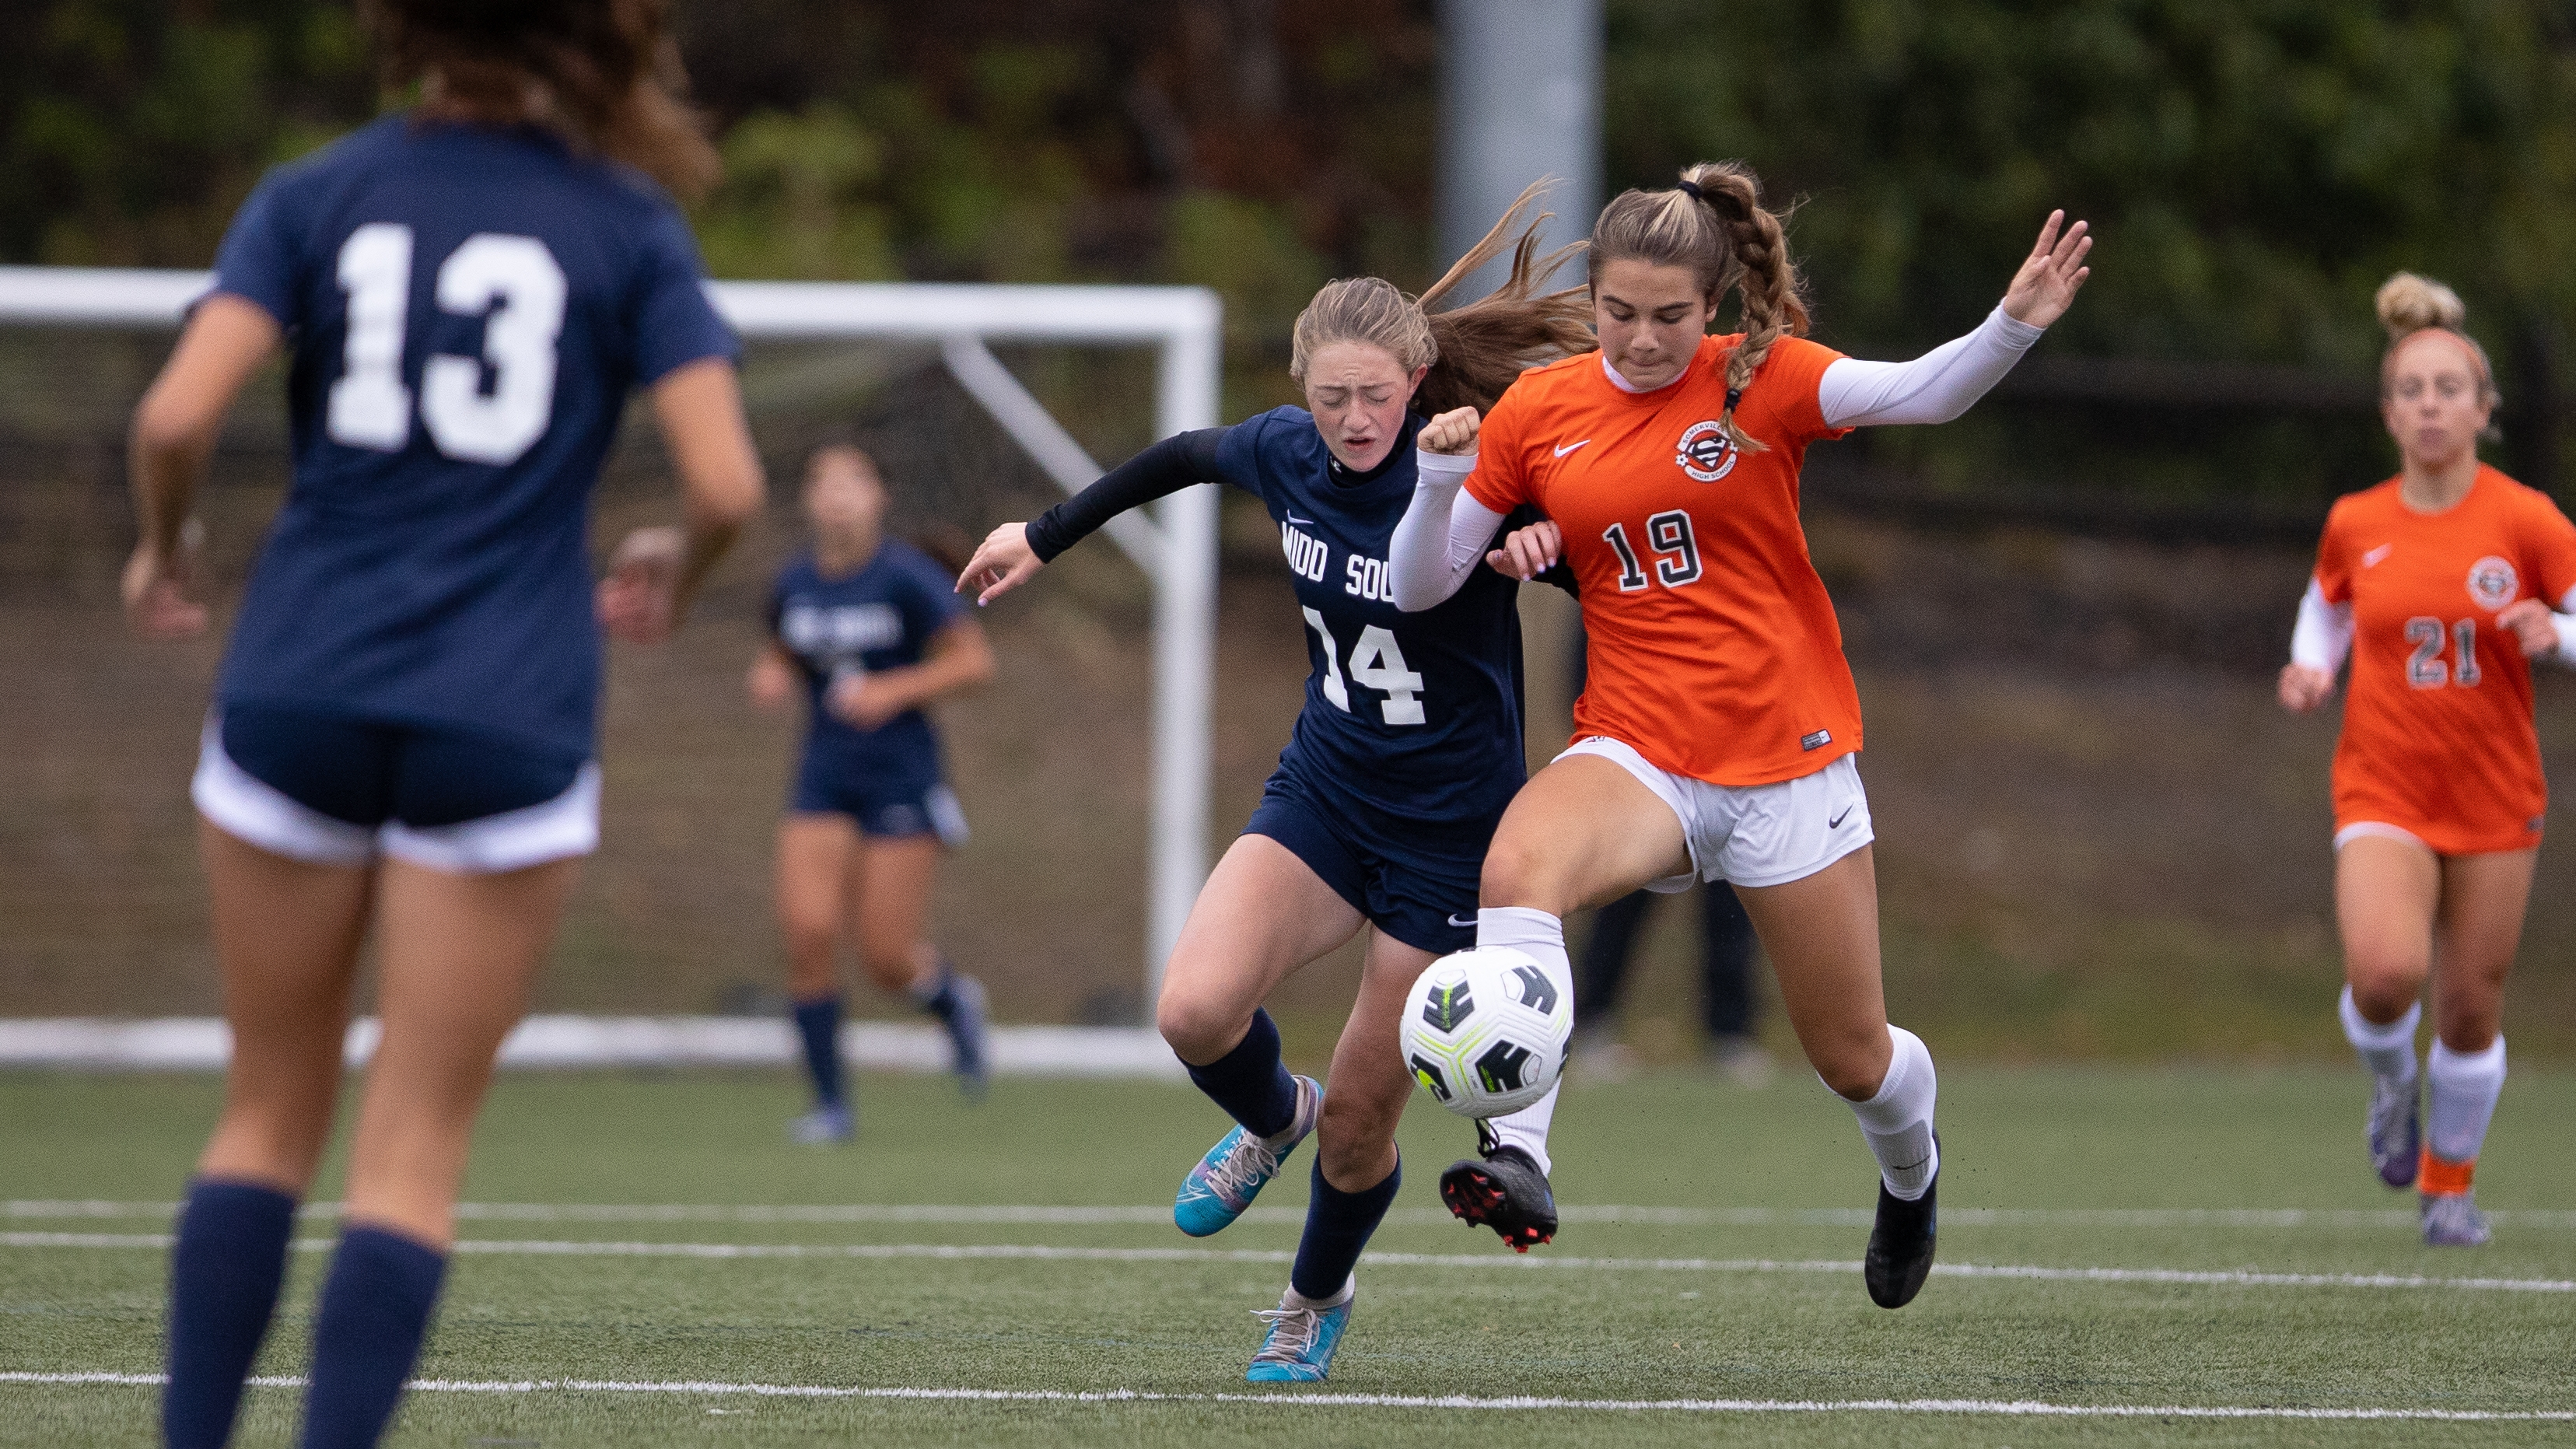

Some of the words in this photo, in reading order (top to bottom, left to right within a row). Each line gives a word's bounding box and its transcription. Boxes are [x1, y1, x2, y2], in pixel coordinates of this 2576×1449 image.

[326, 222, 569, 467] 13
[1682, 422, 1721, 444] SOMERVILL
[1692, 471, 1710, 480] HIGH
[1711, 460, 1734, 479] SCHOOL
[1282, 520, 1328, 583] MIDD
[1345, 553, 1395, 603] SOU
[1602, 509, 1703, 592] 19
[1303, 605, 1426, 724] 14
[2404, 615, 2482, 690] 21
